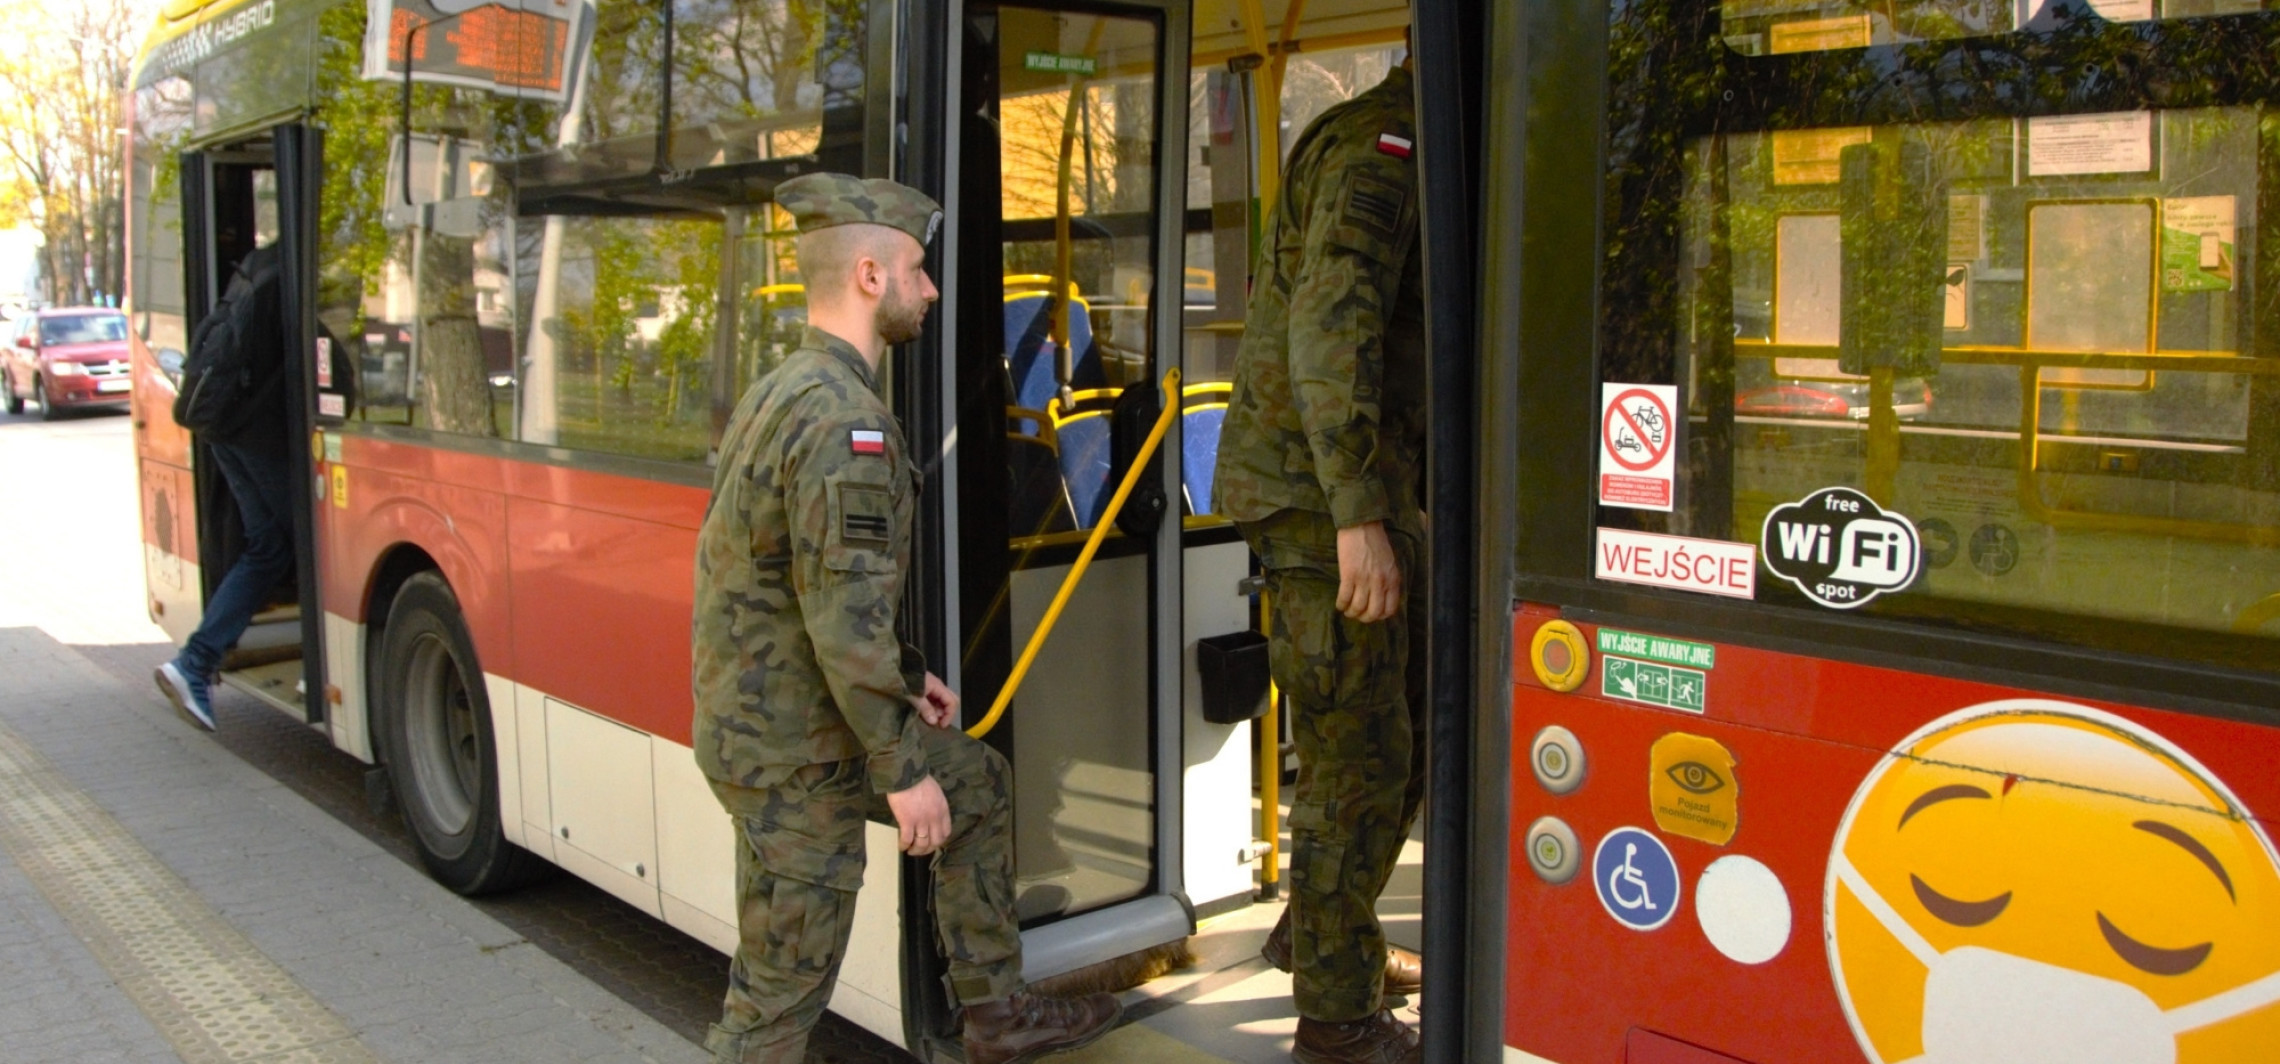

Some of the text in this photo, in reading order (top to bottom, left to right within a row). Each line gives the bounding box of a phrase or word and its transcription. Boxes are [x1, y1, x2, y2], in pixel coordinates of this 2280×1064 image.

[214, 0, 275, 46] HYBRID
[1825, 494, 1860, 512] free
[1603, 542, 1748, 589] WEJŚCIE
[1816, 583, 1856, 600] spot
[1600, 632, 1712, 666] WYJŚCIE AWARYJNE
[1677, 797, 1711, 813] Pojazd
[1659, 806, 1728, 830] monitorowany
